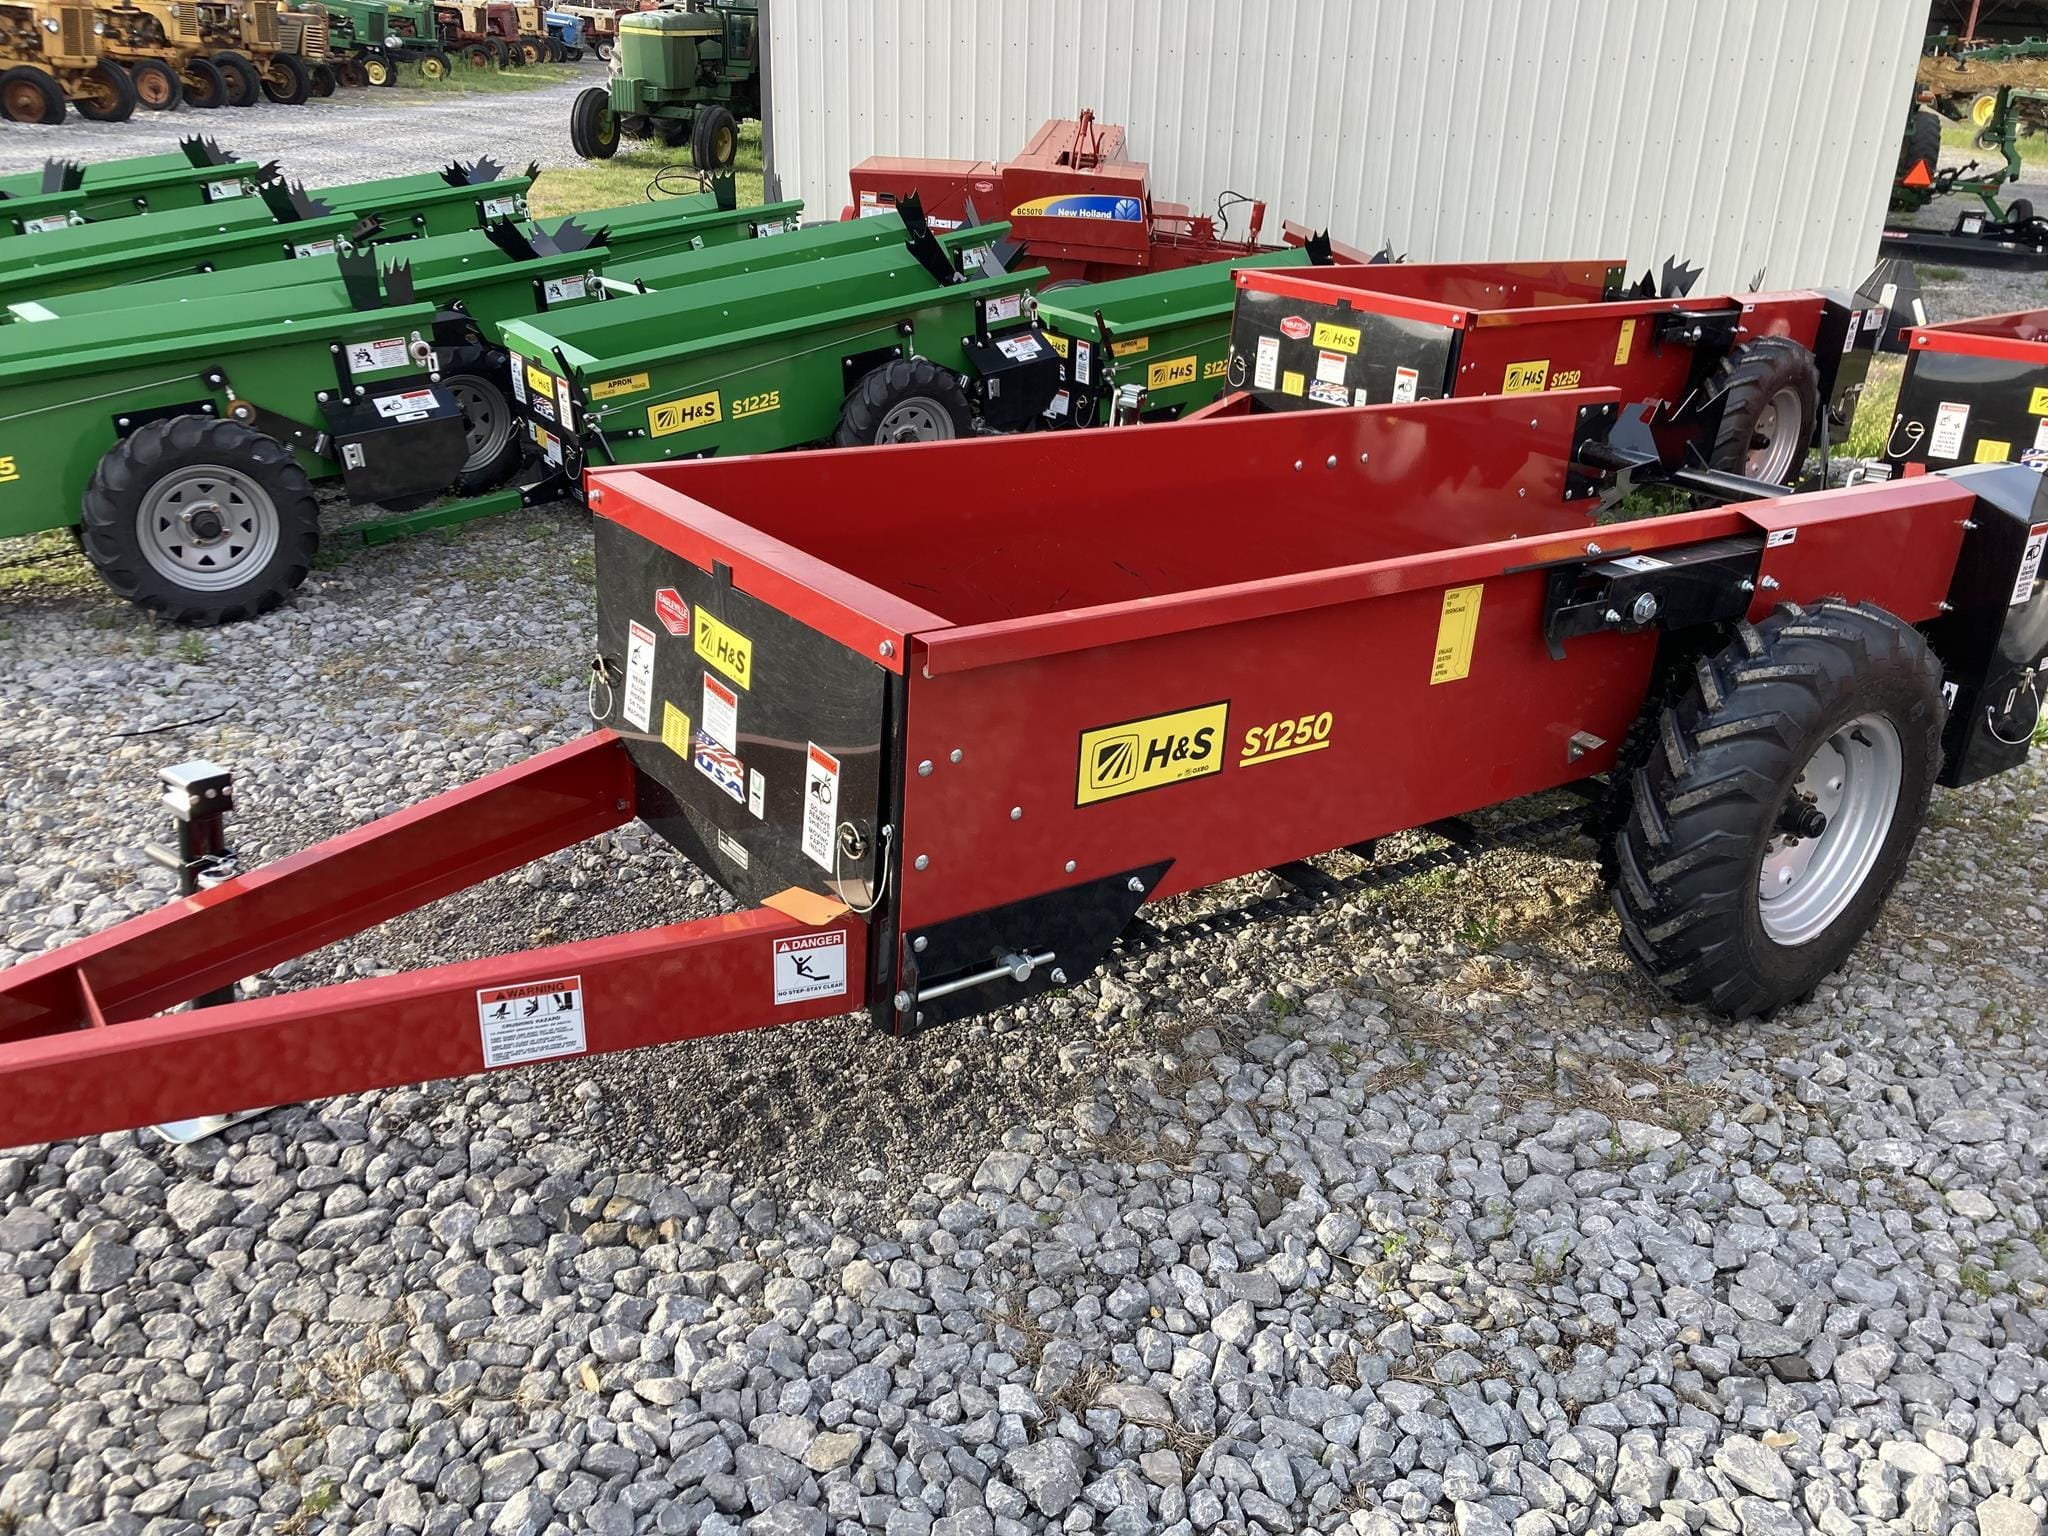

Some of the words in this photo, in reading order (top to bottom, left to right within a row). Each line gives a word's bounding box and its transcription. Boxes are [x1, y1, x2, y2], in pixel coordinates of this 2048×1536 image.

[1017, 208, 1043, 216] BC5070
[1058, 208, 1078, 217] New
[1080, 209, 1112, 219] Holland
[1333, 334, 1356, 347] H&S
[1169, 363, 1193, 380] H&S
[1522, 369, 1545, 387] H&S
[1551, 369, 1581, 387] S1250
[608, 378, 632, 389] APRON
[732, 390, 780, 414] S1225
[681, 401, 715, 425] H&S
[1445, 606, 1466, 615] DISENGAGE
[716, 637, 747, 675] H&S
[1438, 647, 1453, 655] ENGAGE
[1240, 711, 1334, 758] S1250
[1143, 727, 1216, 773] H&S
[697, 753, 744, 799] USA
[792, 934, 841, 950] DANGER
[507, 982, 565, 998] WARNING
[822, 982, 843, 990] CLEAR
[502, 1019, 534, 1030] CRUSHING
[535, 1015, 561, 1024] HAZARD
